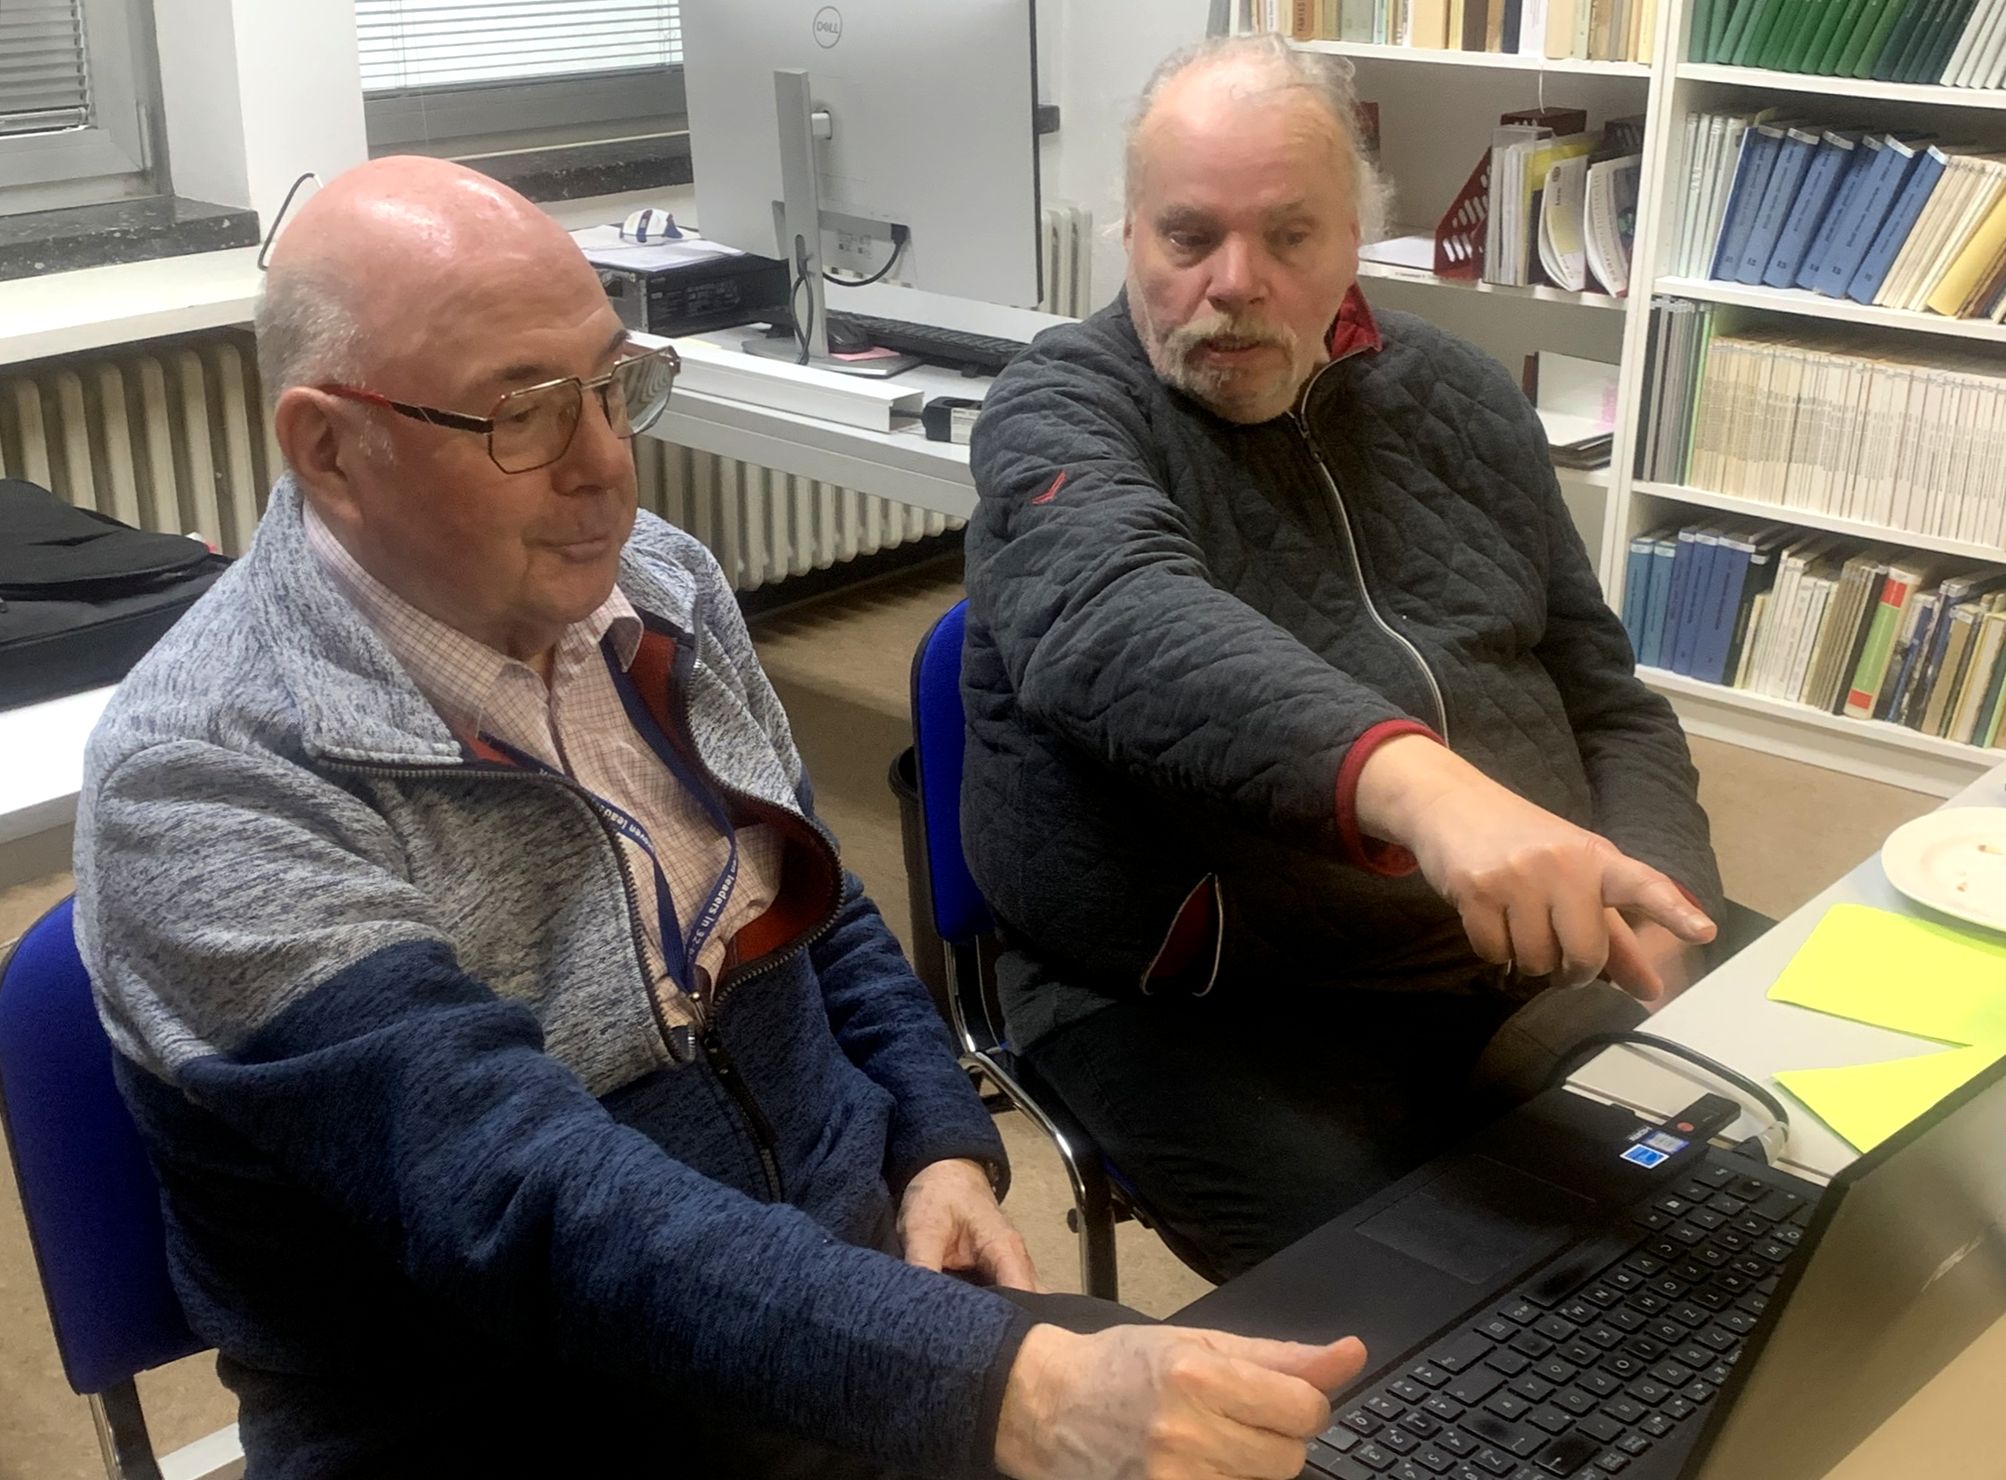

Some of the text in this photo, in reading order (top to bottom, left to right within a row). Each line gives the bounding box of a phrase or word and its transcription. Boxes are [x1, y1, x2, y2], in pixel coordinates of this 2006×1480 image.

[816, 21, 838, 34] DELL
[708, 874, 735, 915] leaders
[1726, 1235, 1739, 1244] S
[1660, 1244, 1672, 1252] C
[1706, 1250, 1719, 1259] D
[1746, 1261, 1760, 1270] E
[1617, 1274, 1630, 1283] B
[1663, 1281, 1677, 1290] G
[1594, 1289, 1609, 1298] N
[1641, 1297, 1655, 1307] H
[1570, 1305, 1585, 1315] M
[1683, 1308, 1697, 1318] Z
[1597, 1329, 1610, 1339] K
[1661, 1325, 1676, 1334] U
[1616, 1359, 1630, 1369] O
[1390, 1435, 1403, 1444] 2
[1368, 1451, 1381, 1461] 3
[1427, 1454, 1440, 1463] 5
[1490, 1456, 1501, 1466] 7
[1404, 1469, 1417, 1479] 6
